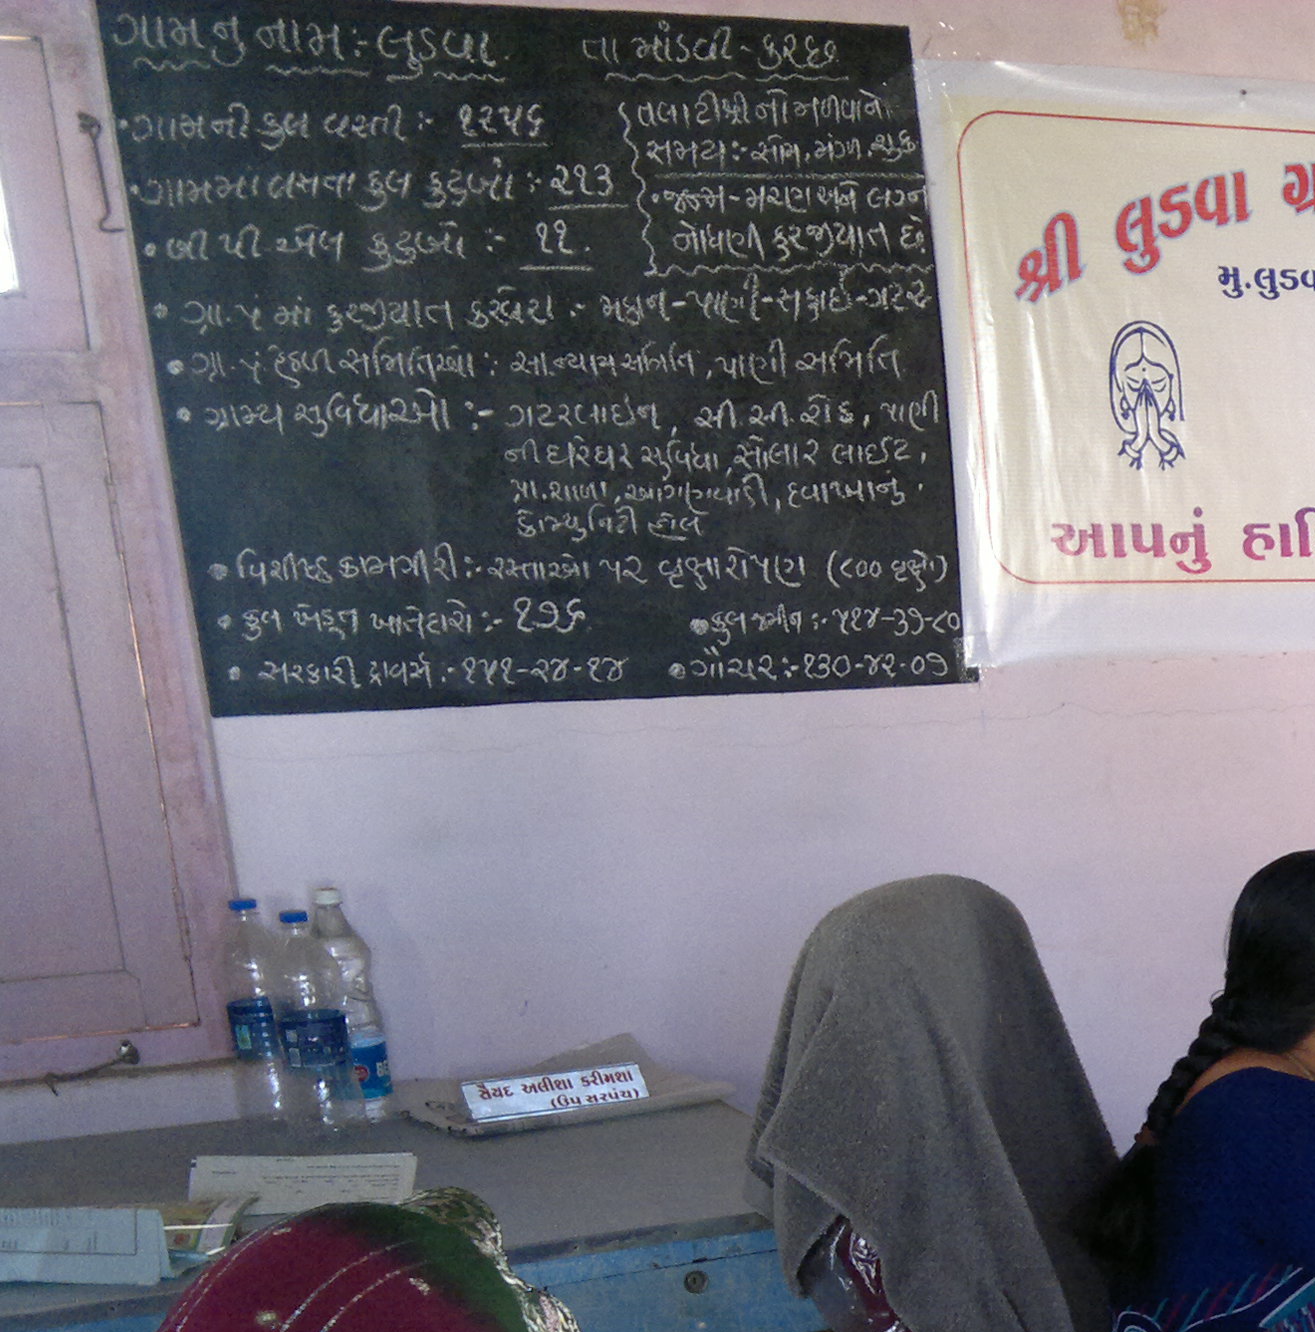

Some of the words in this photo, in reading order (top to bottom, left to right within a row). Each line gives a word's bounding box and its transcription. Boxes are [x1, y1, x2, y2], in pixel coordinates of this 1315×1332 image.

[113, 13, 206, 48] ગામ
[1014, 210, 1085, 303] શ્રી
[1115, 169, 1252, 275] લુડવા
[1050, 506, 1213, 575] આપનું
[599, 555, 649, 584] પર
[520, 1075, 575, 1096] અલીશા
[580, 1069, 634, 1089] કરીમશા
